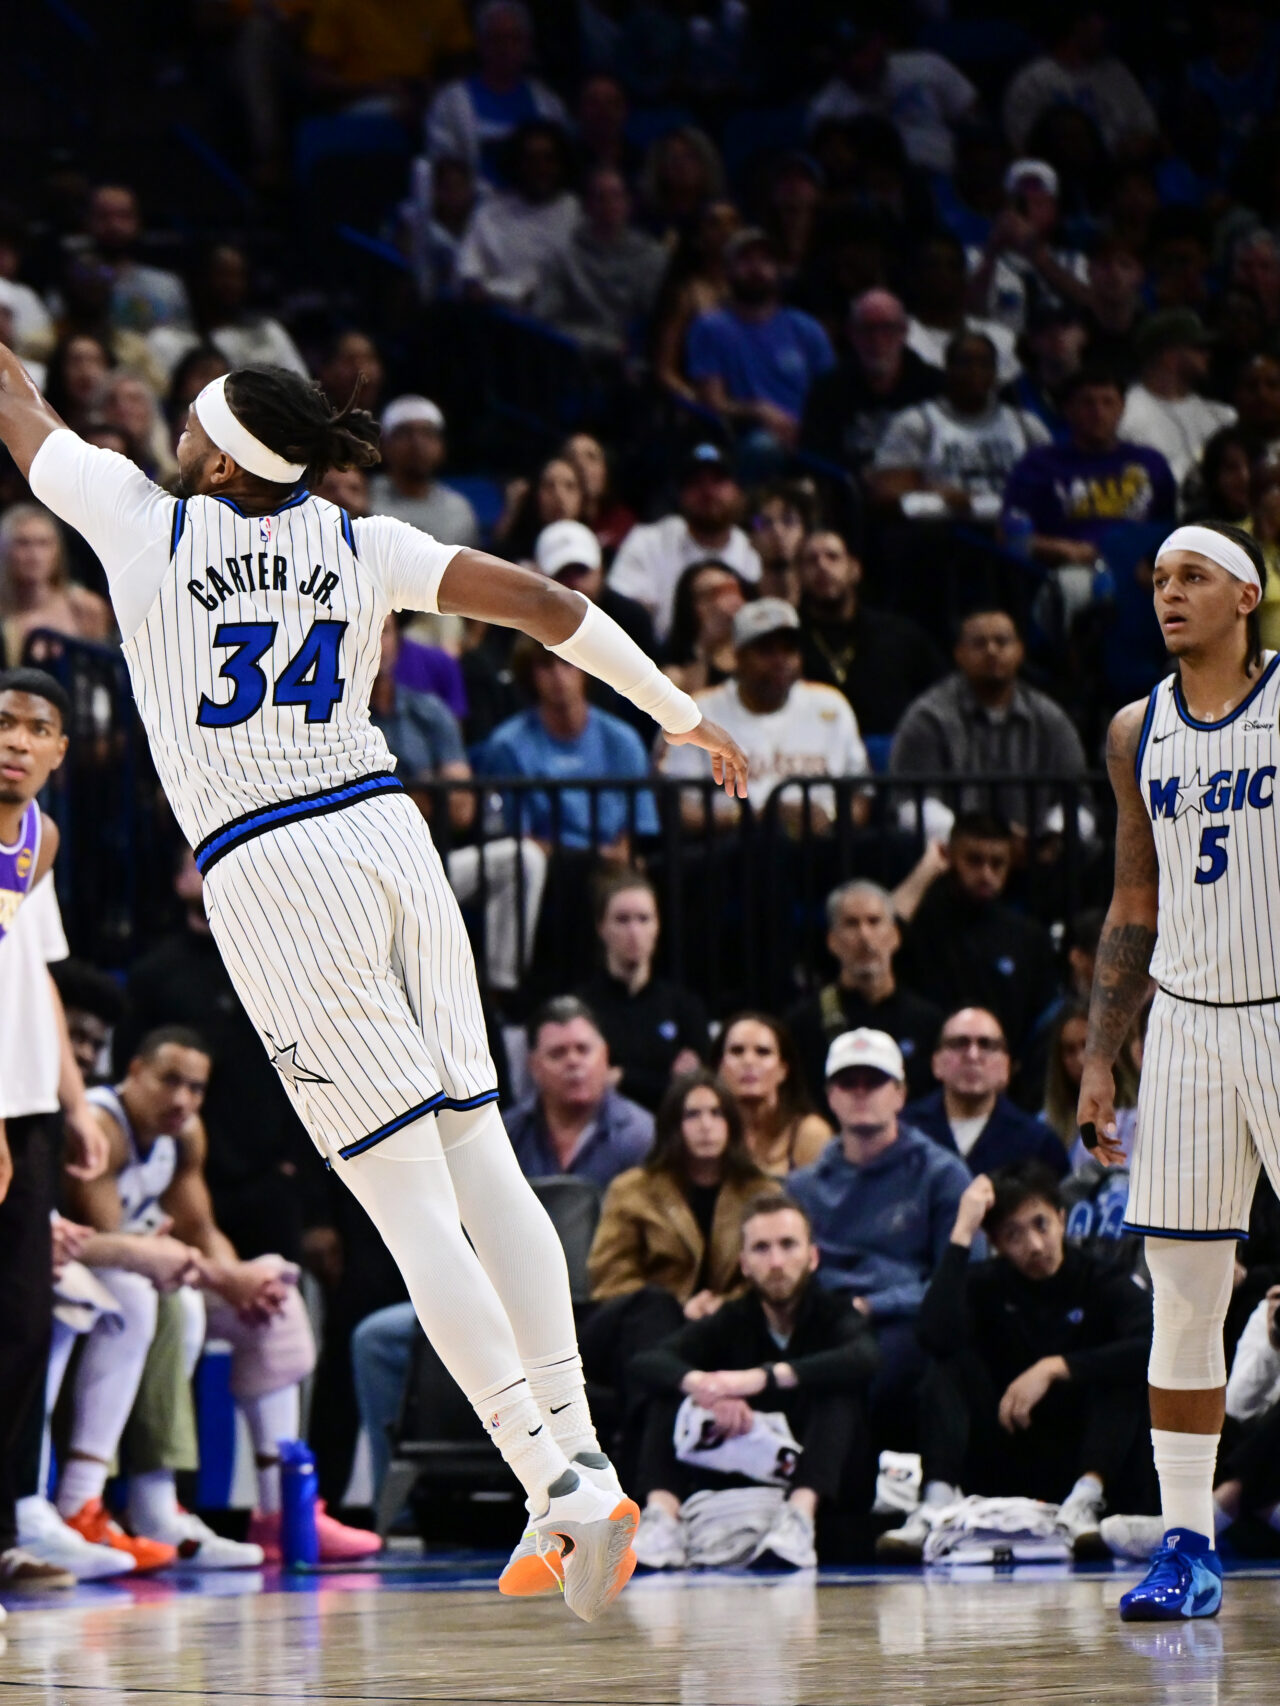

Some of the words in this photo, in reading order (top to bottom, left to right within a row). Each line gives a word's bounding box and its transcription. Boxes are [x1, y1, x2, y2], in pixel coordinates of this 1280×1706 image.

[187, 552, 287, 611] CARTER
[299, 564, 340, 611] JR.
[195, 619, 350, 729] 34
[1194, 825, 1231, 885] 5
